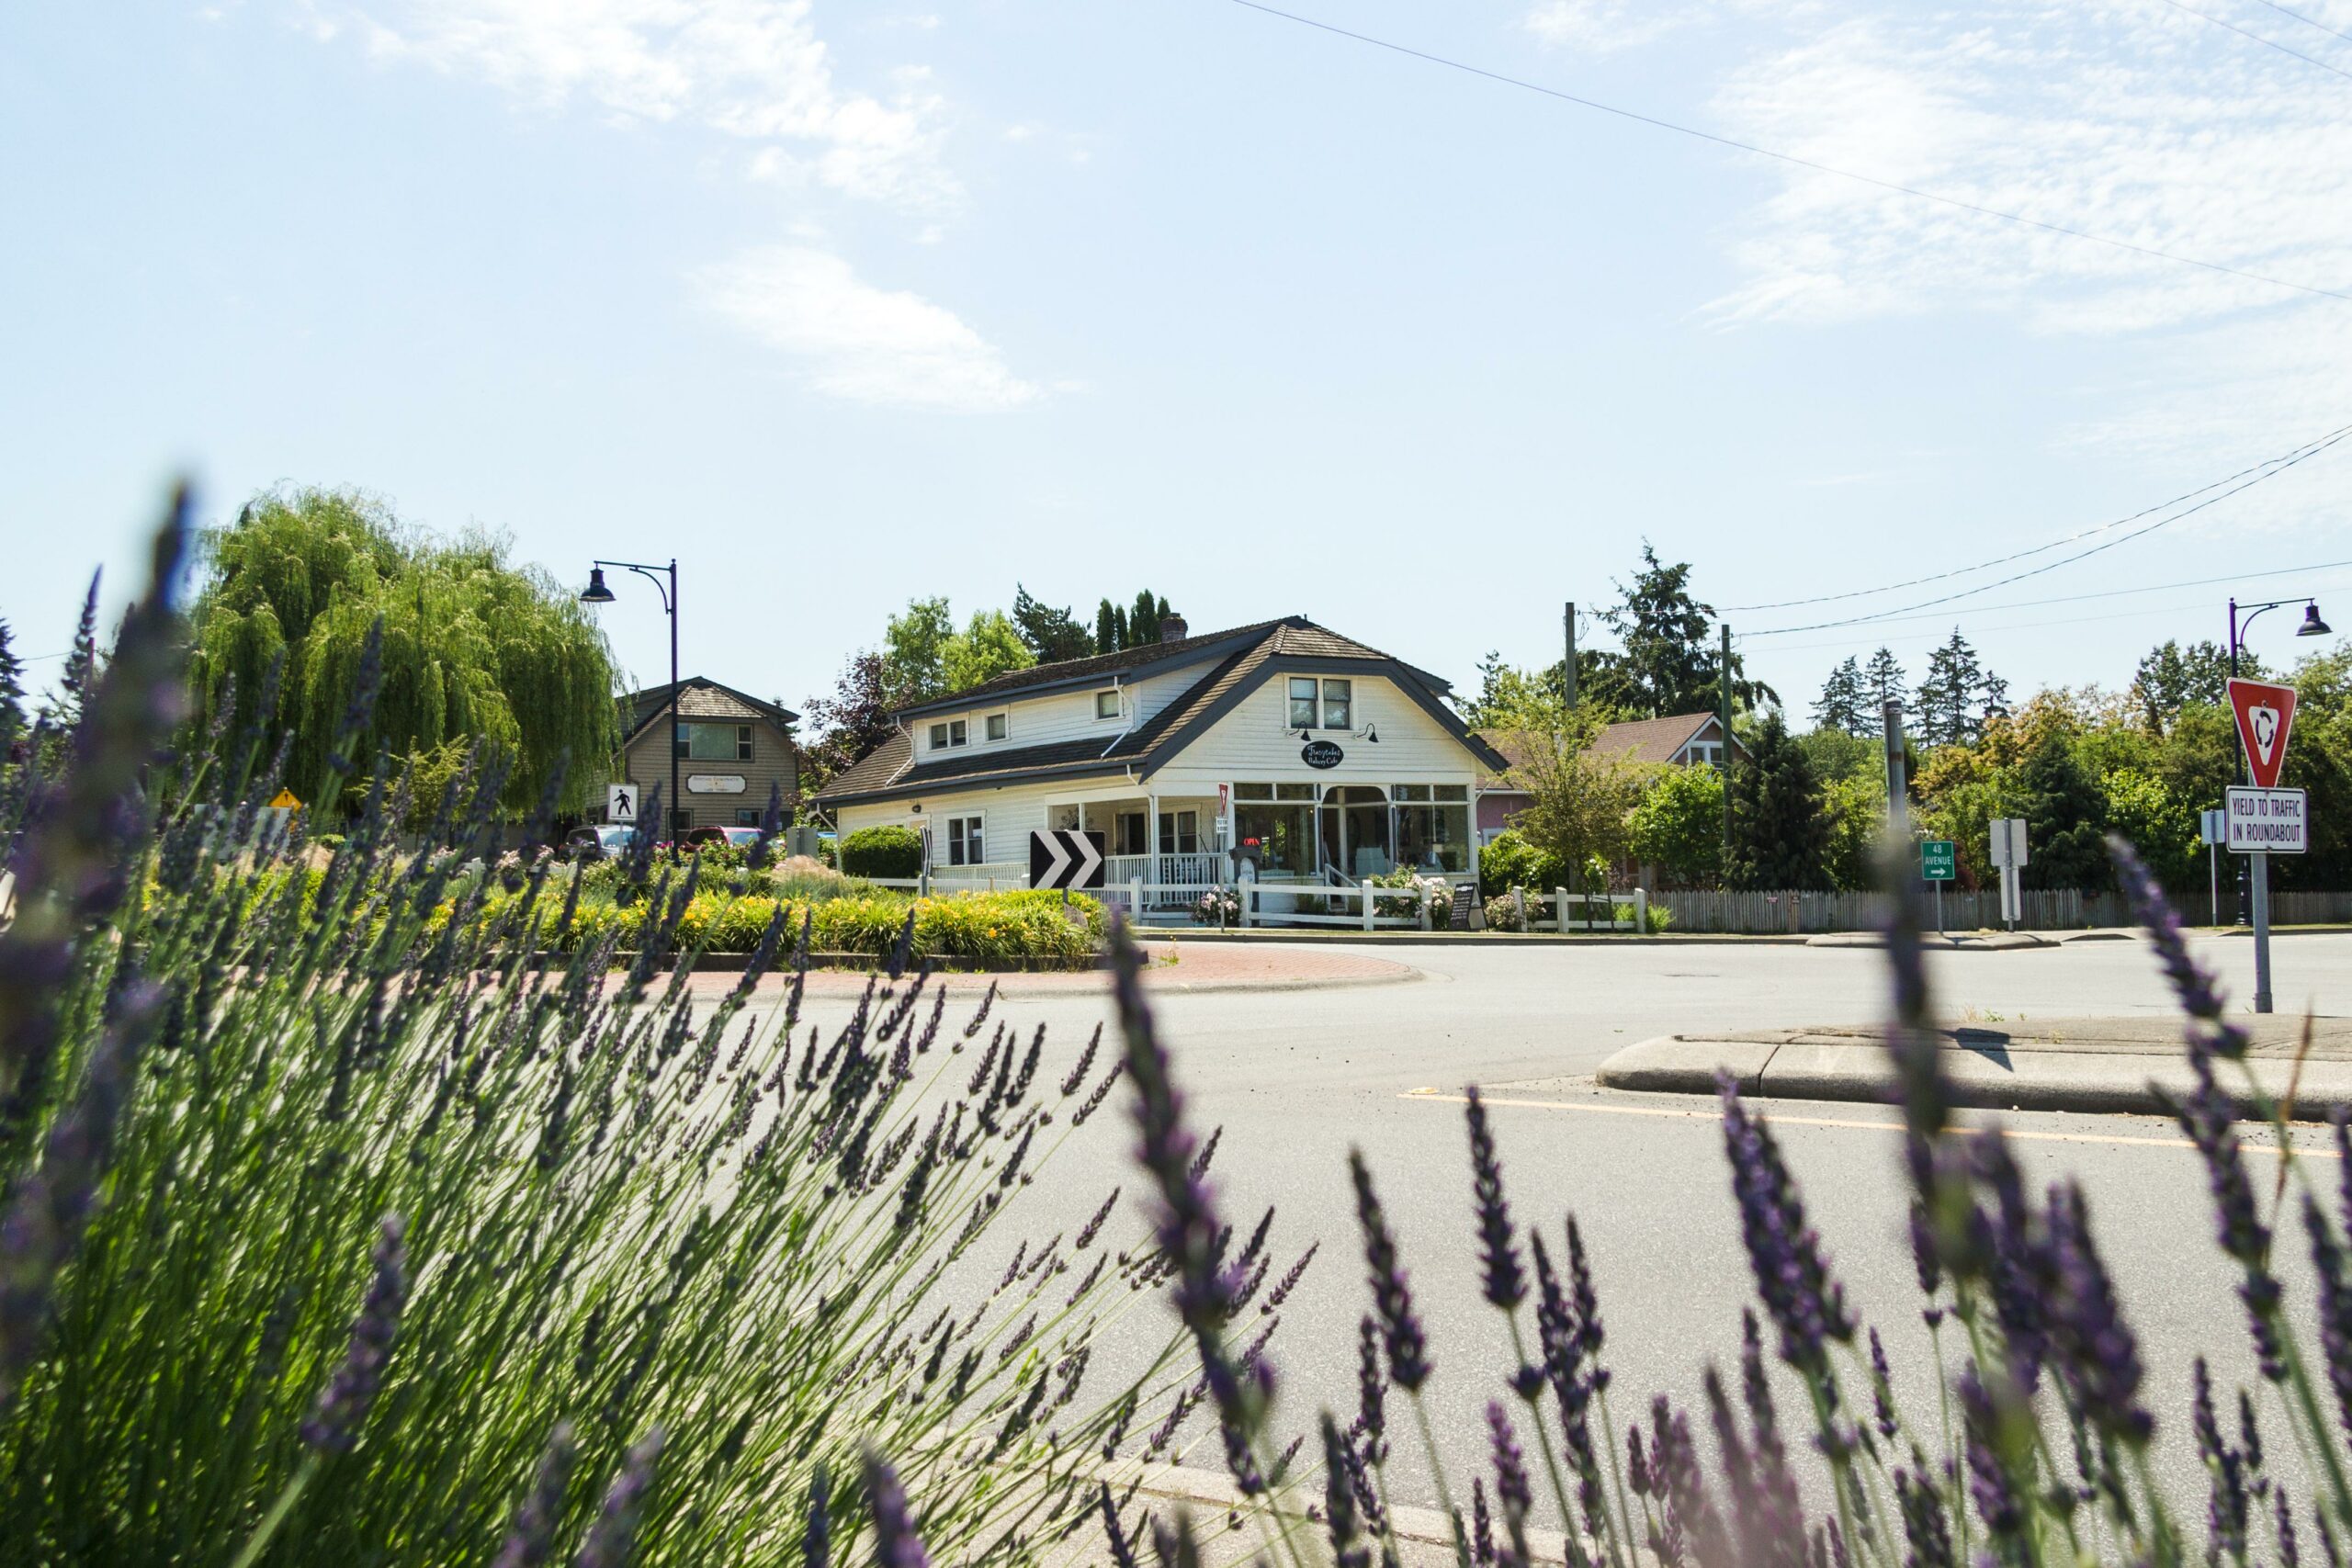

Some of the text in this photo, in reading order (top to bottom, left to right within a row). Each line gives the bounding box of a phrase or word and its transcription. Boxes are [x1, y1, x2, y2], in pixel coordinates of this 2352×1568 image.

[2232, 797, 2301, 818] YIELD TO TRAFFIC
[2233, 823, 2301, 842] IN ROUNDABOUT
[1244, 838, 1260, 846] OPEN
[1932, 845, 1942, 854] 48
[1925, 856, 1951, 865] AVENUE
